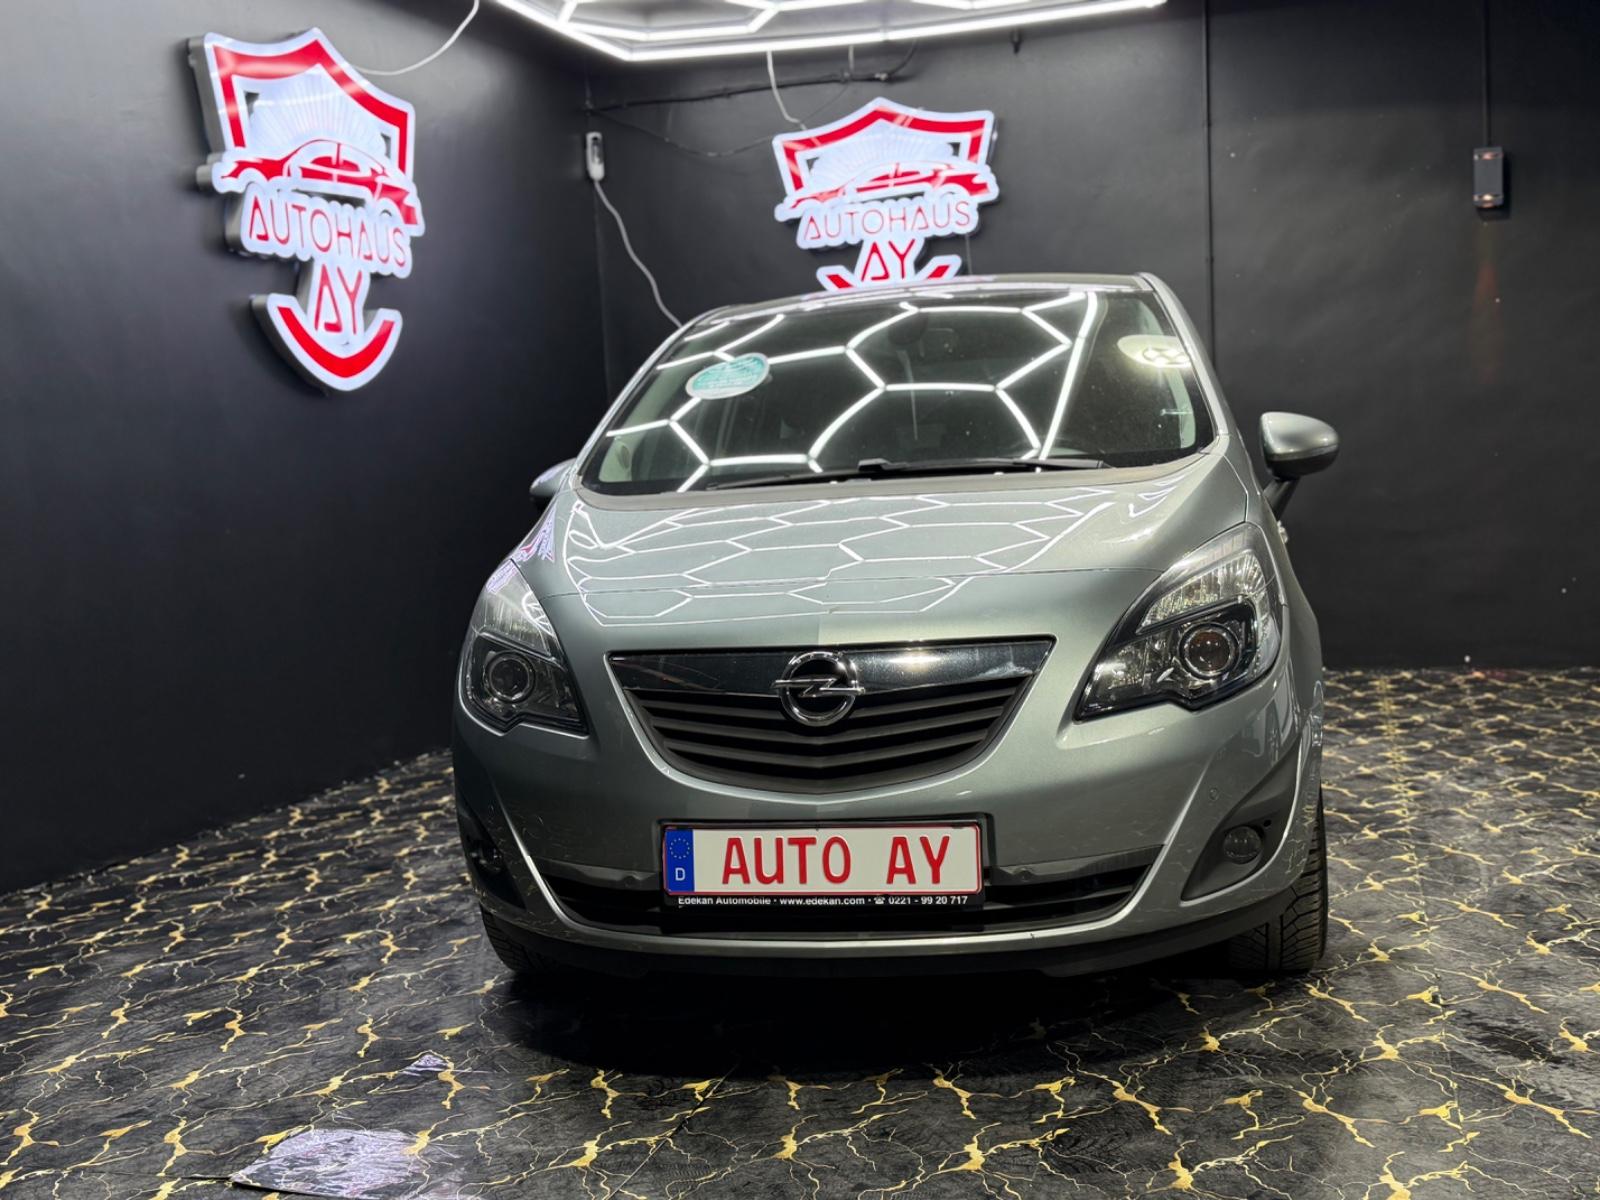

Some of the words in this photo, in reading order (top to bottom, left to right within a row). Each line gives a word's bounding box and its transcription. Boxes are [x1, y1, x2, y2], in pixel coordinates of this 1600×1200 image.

[249, 194, 408, 268] AUTOHAUS
[803, 200, 970, 240] AUTOHAUS
[861, 238, 916, 282] AY
[314, 263, 363, 335] AY
[675, 867, 686, 881] D
[721, 836, 851, 885] AUTO
[886, 835, 950, 885] AY
[678, 896, 714, 905] Edekan
[715, 896, 772, 905] Automobile
[779, 896, 866, 906] www.edekan.com
[888, 896, 911, 905] 0221
[920, 896, 933, 905] 99
[935, 896, 948, 905] 20
[950, 896, 968, 905] 717
